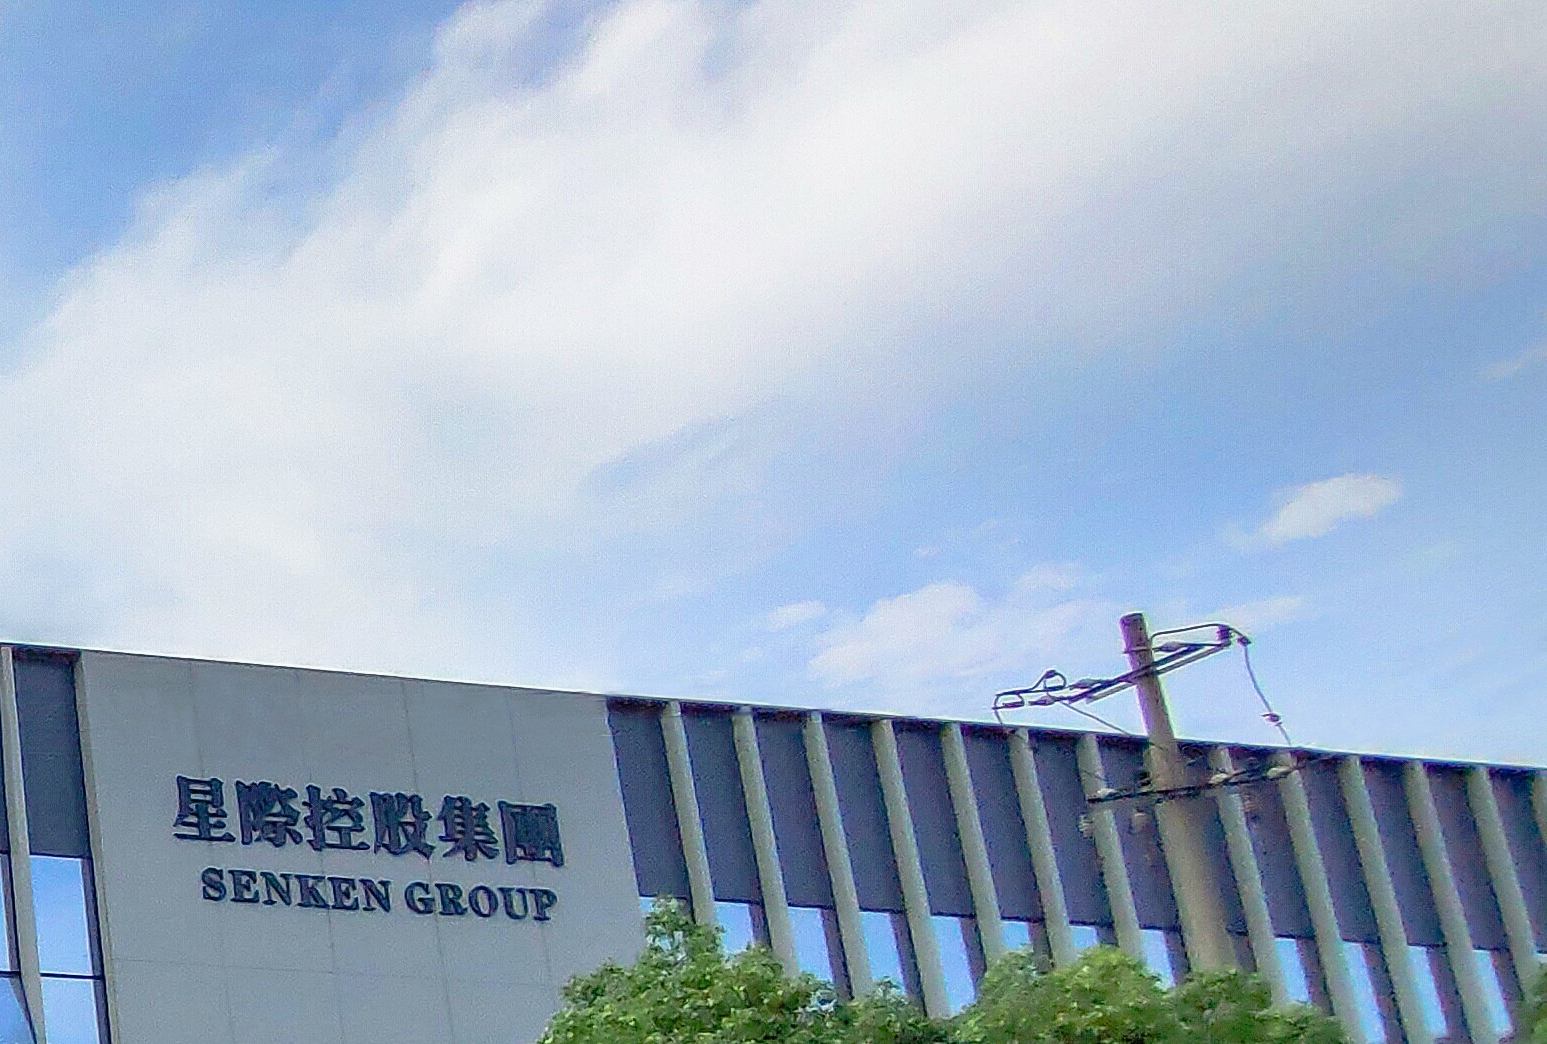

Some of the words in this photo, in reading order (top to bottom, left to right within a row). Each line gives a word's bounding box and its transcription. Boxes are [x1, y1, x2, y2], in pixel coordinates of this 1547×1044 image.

[173, 775, 565, 867] 星際控股集團
[201, 867, 391, 914] SENKEN
[403, 882, 559, 922] GROUP
